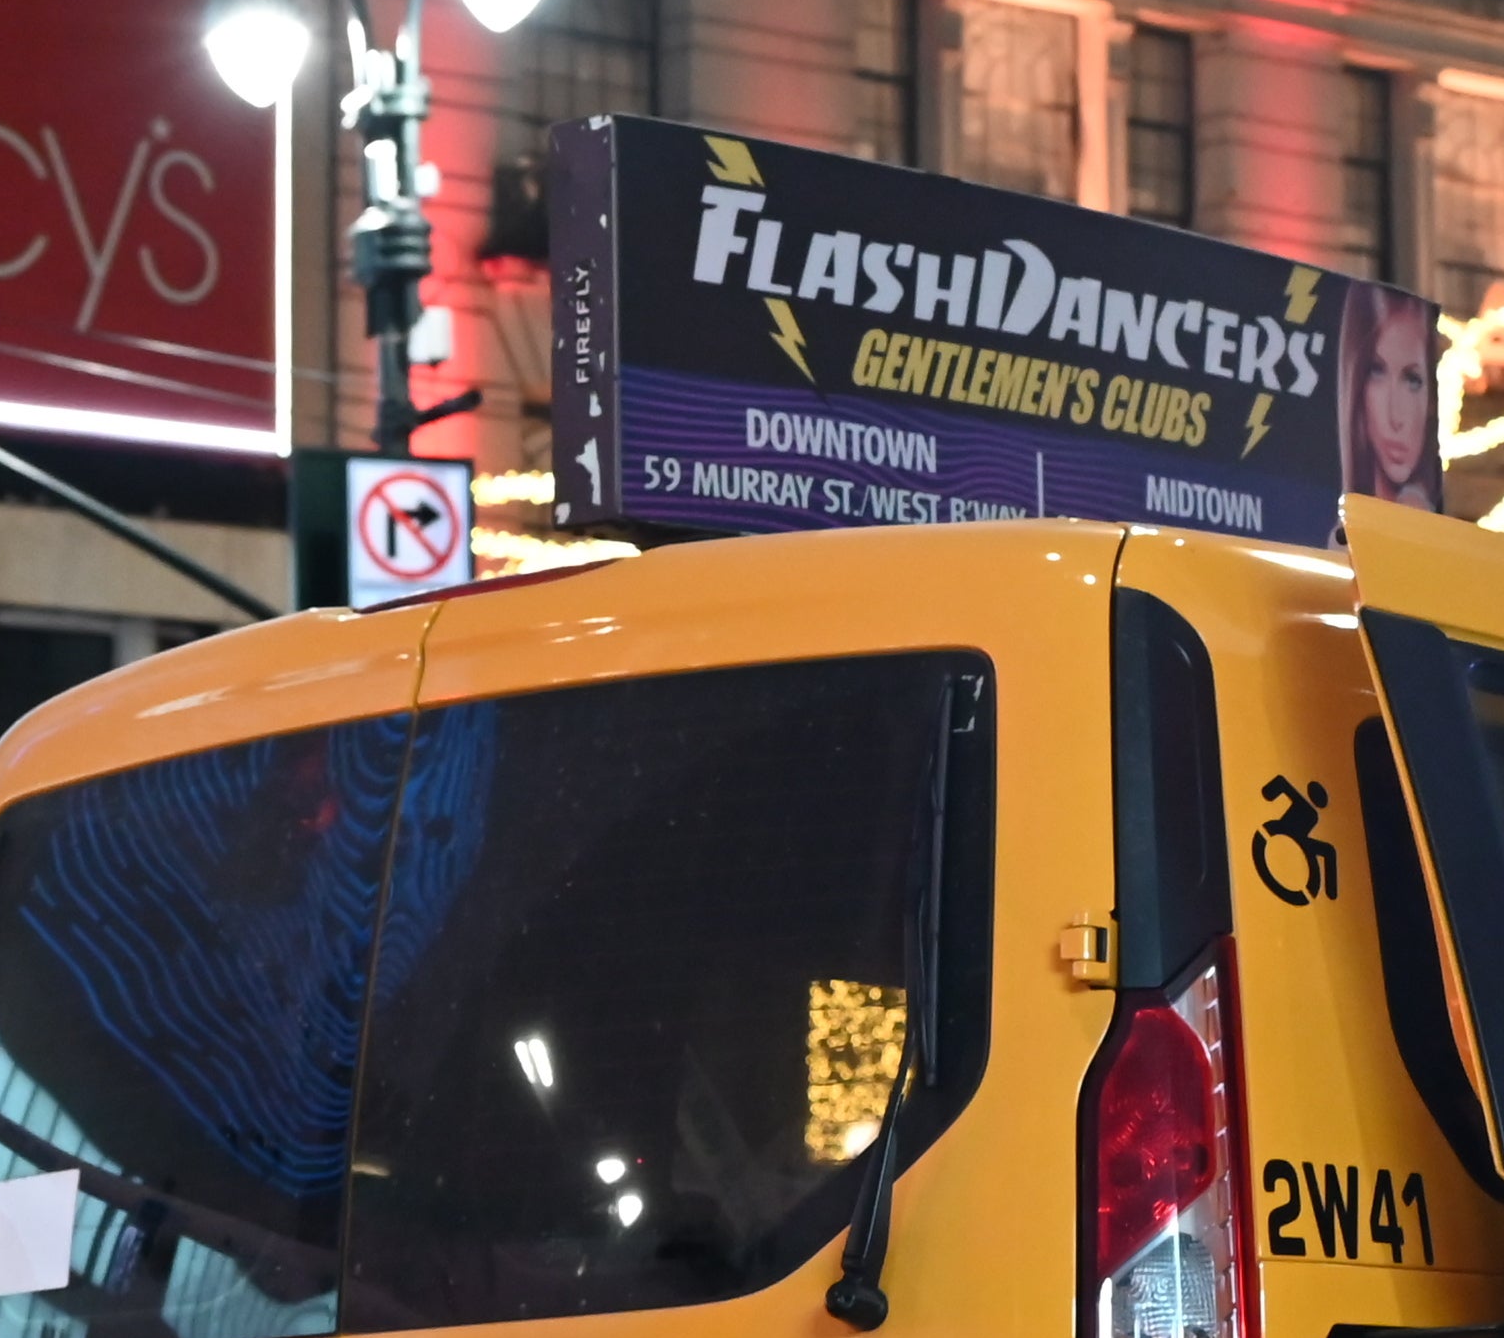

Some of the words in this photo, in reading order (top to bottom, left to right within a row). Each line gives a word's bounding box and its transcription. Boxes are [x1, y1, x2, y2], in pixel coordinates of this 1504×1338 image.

[575, 266, 591, 383] FIREFLY
[851, 329, 1103, 425] GENTLEMEN'S
[1102, 374, 1212, 448] CLUBS
[643, 455, 681, 490] 59
[693, 461, 812, 510] MURRAY
[746, 407, 937, 473] DOWNTOWN
[1146, 474, 1263, 533] MIDTOWN
[1262, 1159, 1435, 1265] 2W41
